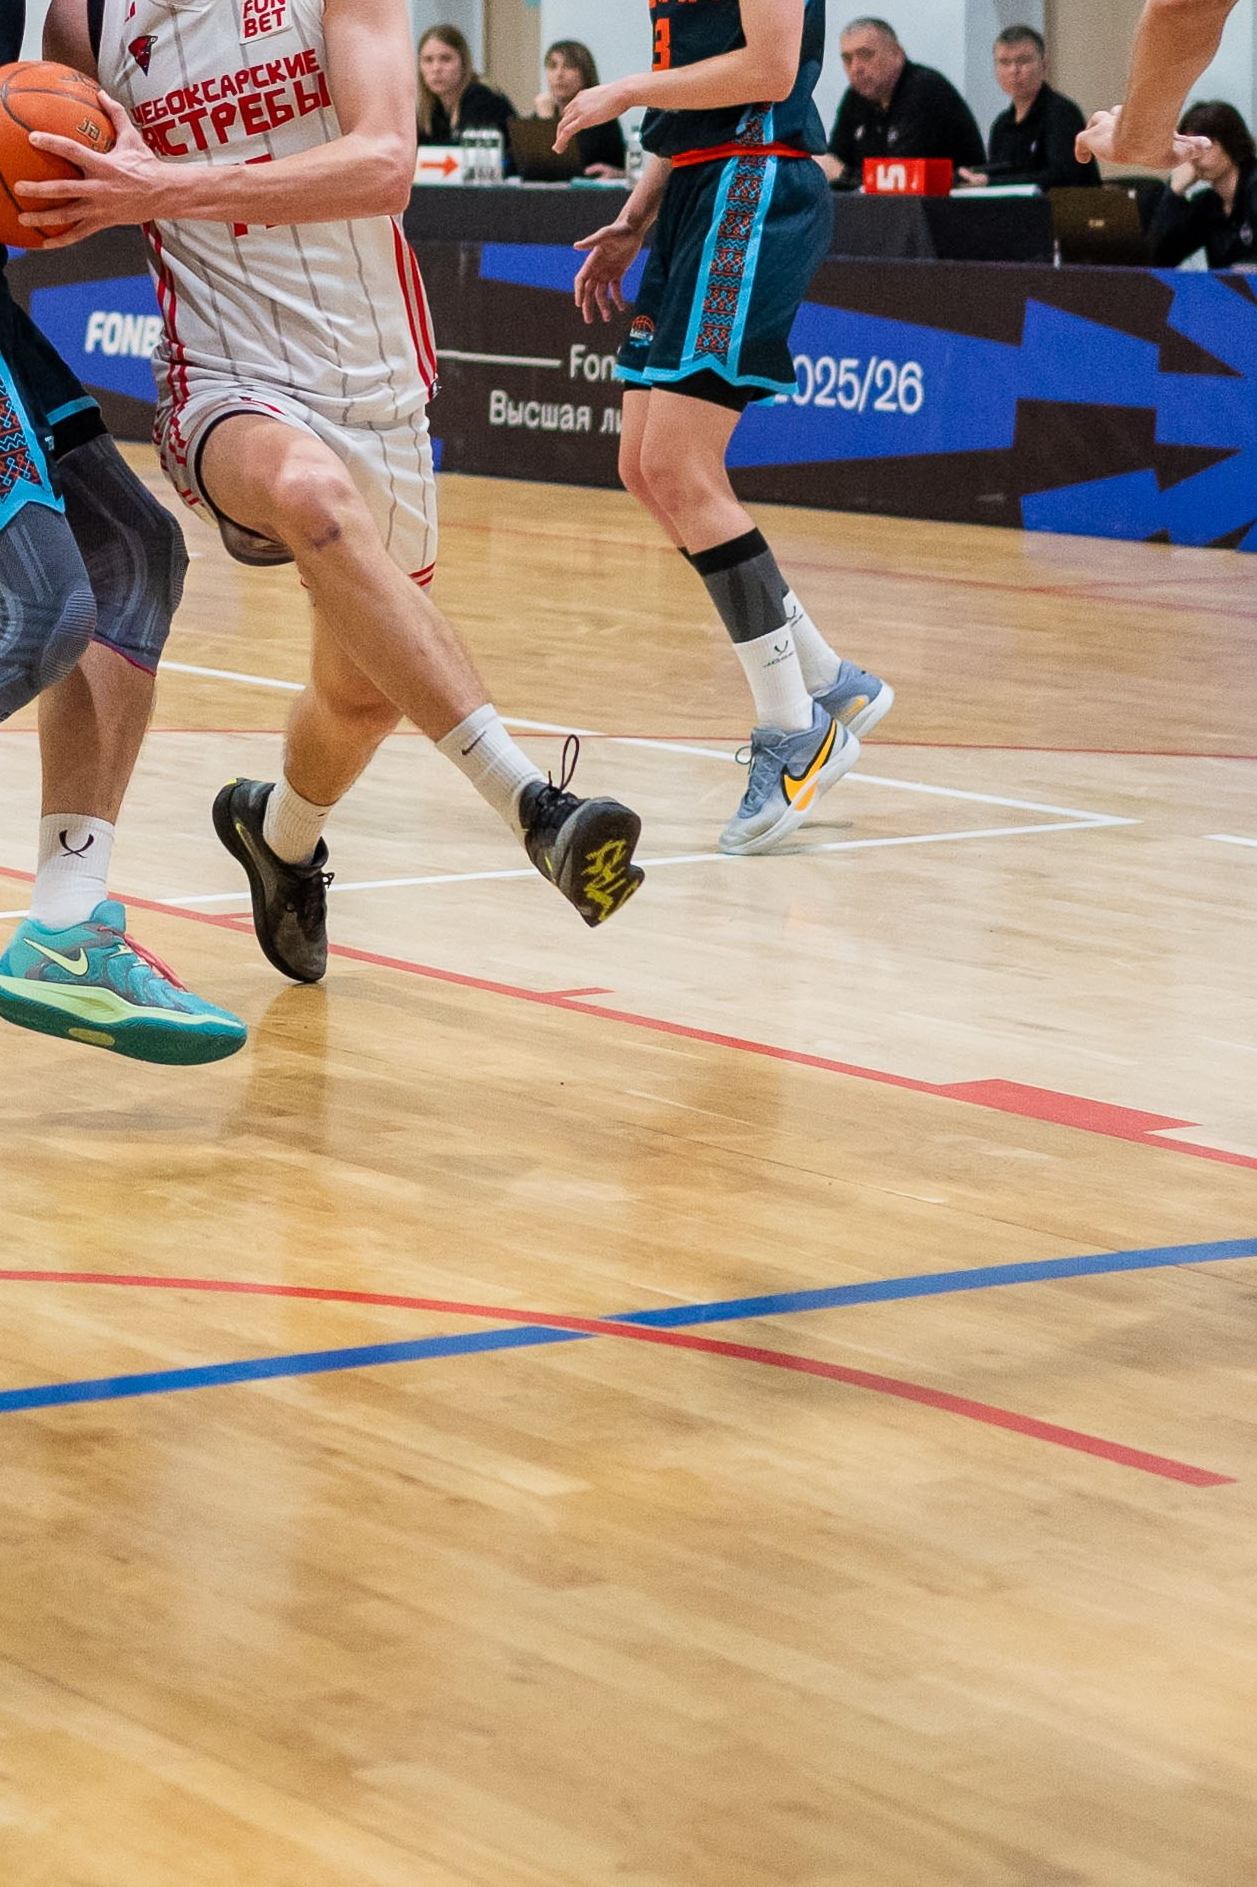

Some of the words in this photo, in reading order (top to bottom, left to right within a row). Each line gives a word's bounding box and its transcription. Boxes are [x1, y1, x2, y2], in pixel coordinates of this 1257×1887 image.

[244, 6, 286, 39] BET
[84, 310, 164, 359] FONB
[569, 343, 624, 383] Fon
[772, 355, 924, 415] 025/26
[489, 389, 592, 433] Высшая
